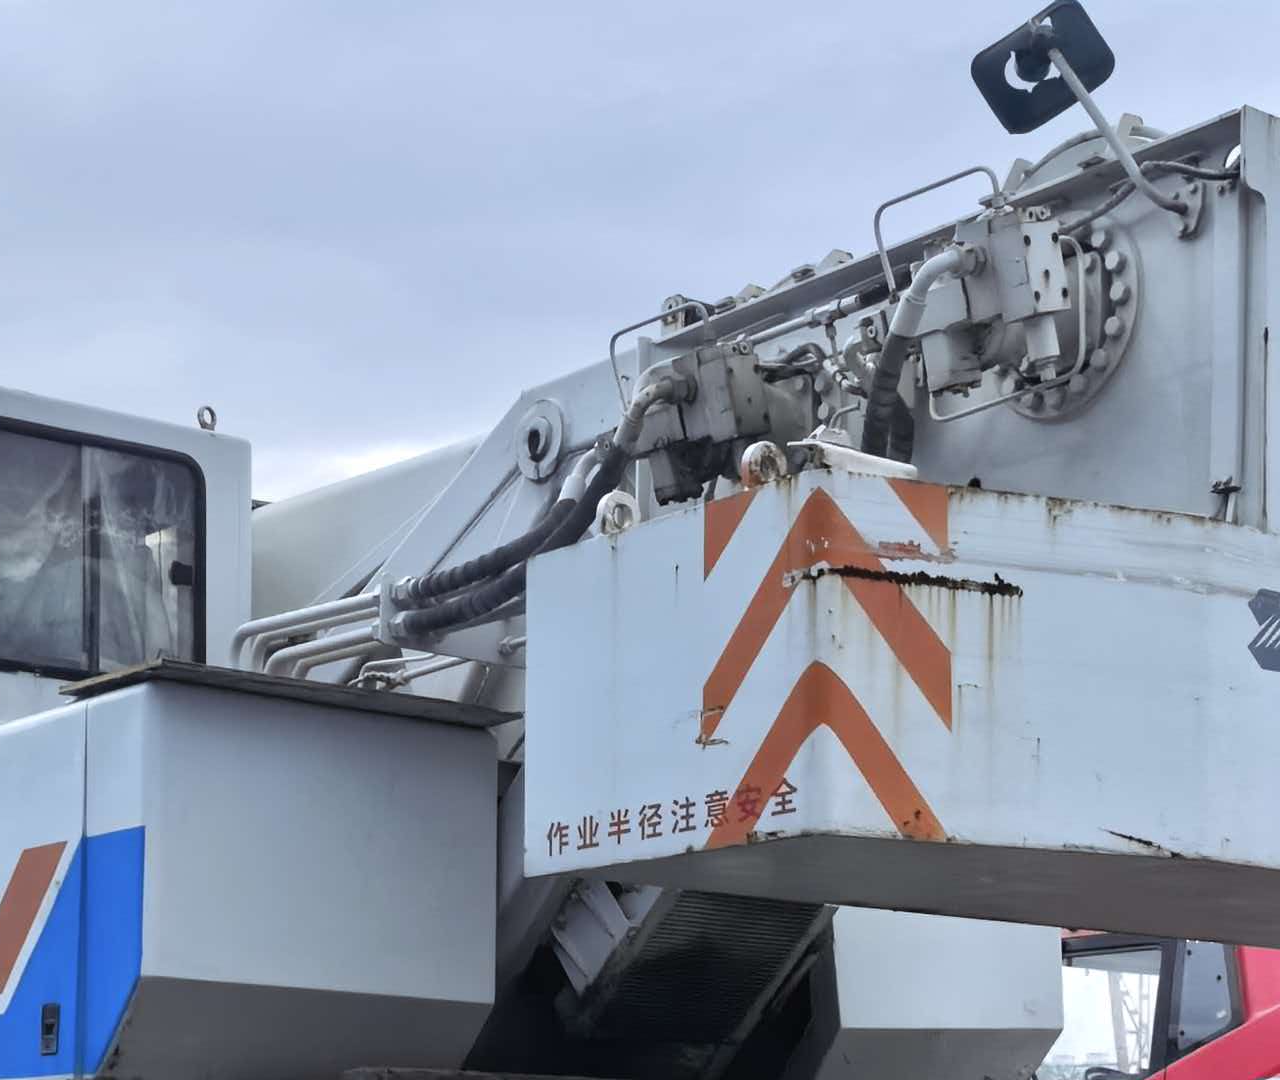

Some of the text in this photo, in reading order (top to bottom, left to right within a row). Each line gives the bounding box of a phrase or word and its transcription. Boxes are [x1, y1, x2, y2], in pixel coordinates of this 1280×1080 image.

[546, 777, 797, 857] 作业半径注意安全
